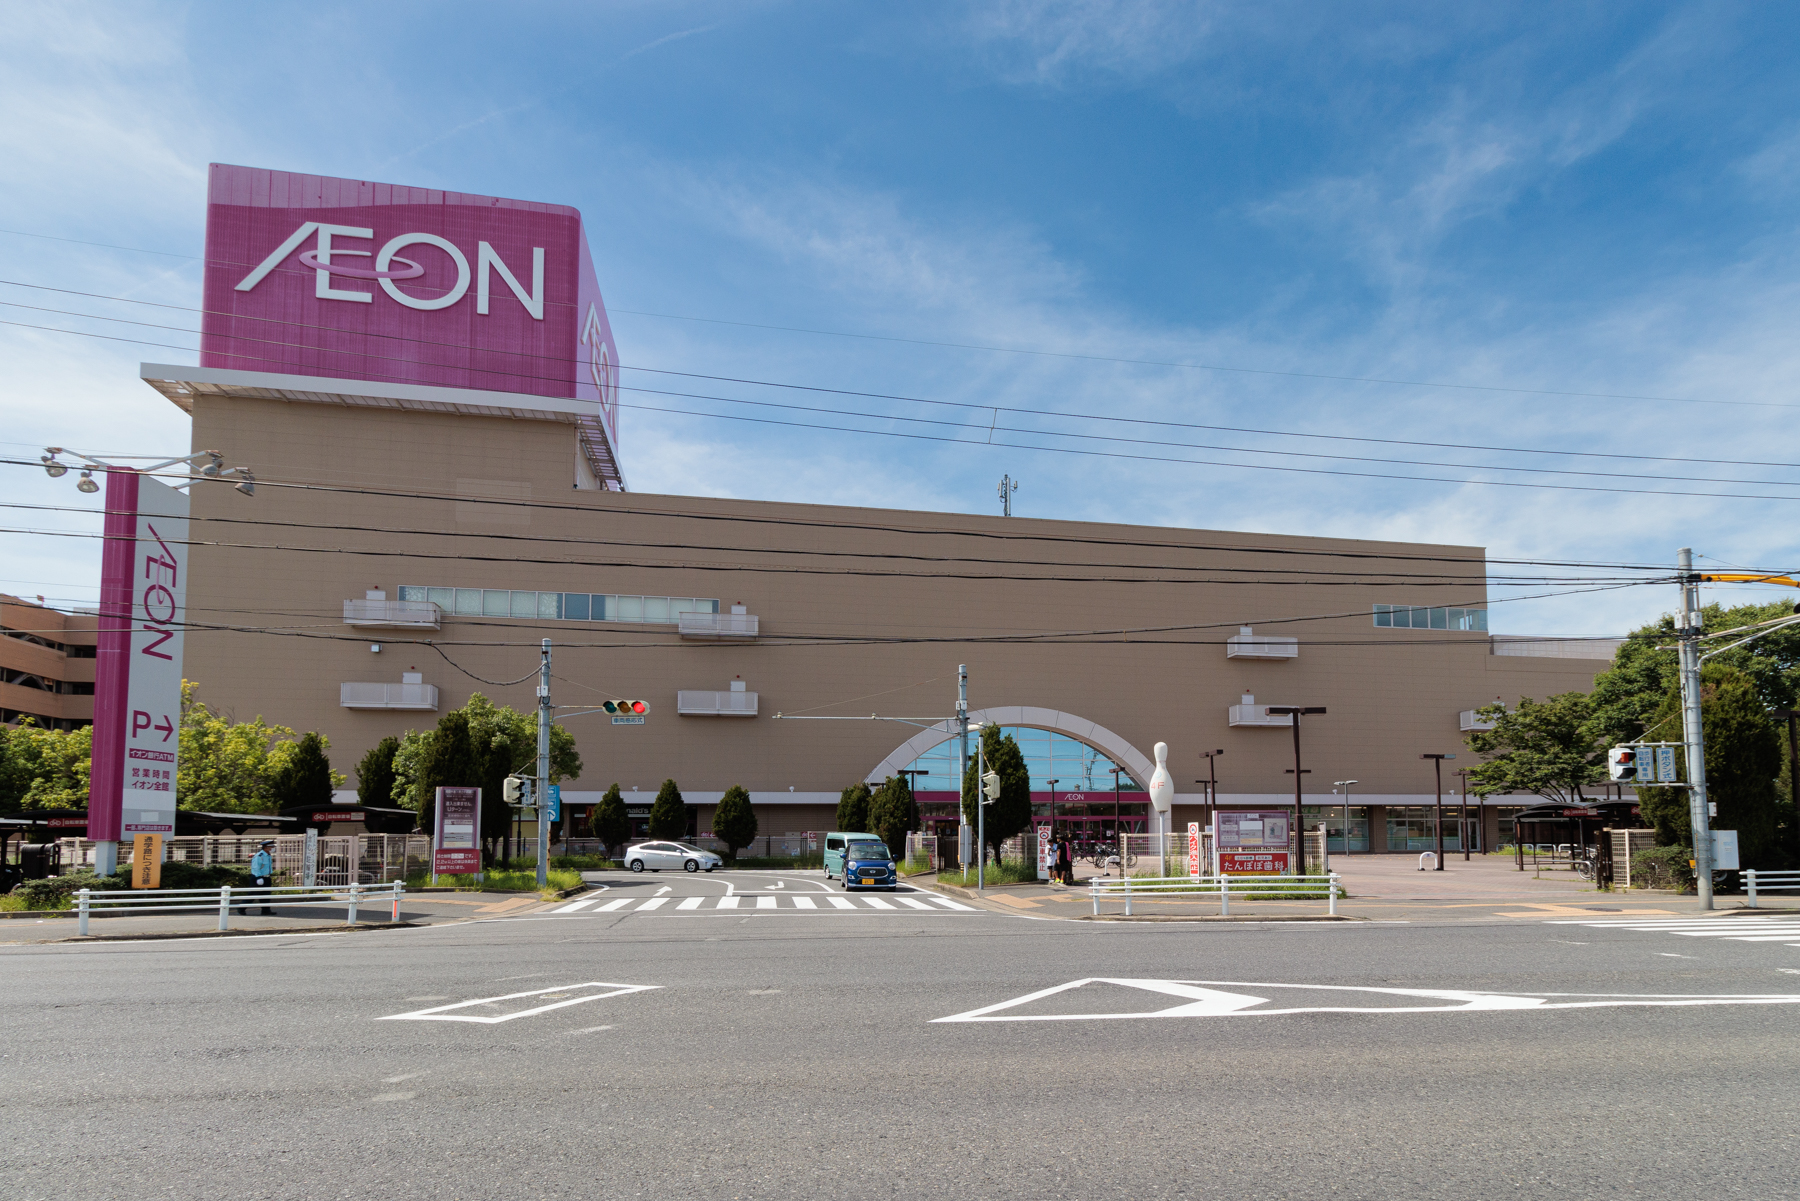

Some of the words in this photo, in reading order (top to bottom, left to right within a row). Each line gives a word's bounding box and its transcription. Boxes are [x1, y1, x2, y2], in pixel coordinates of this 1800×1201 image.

[132, 709, 152, 739] P
[130, 750, 174, 761] イオン銀行ATM
[1660, 750, 1672, 779] 押ボタン式
[132, 767, 170, 780] 営業時間
[131, 780, 170, 792] イオン全館
[1151, 781, 1165, 790] 4F
[141, 835, 154, 886] 通学路につき注意
[1038, 839, 1047, 872] 駐車禁止
[1223, 861, 1285, 871] たんぽぽ歯科
